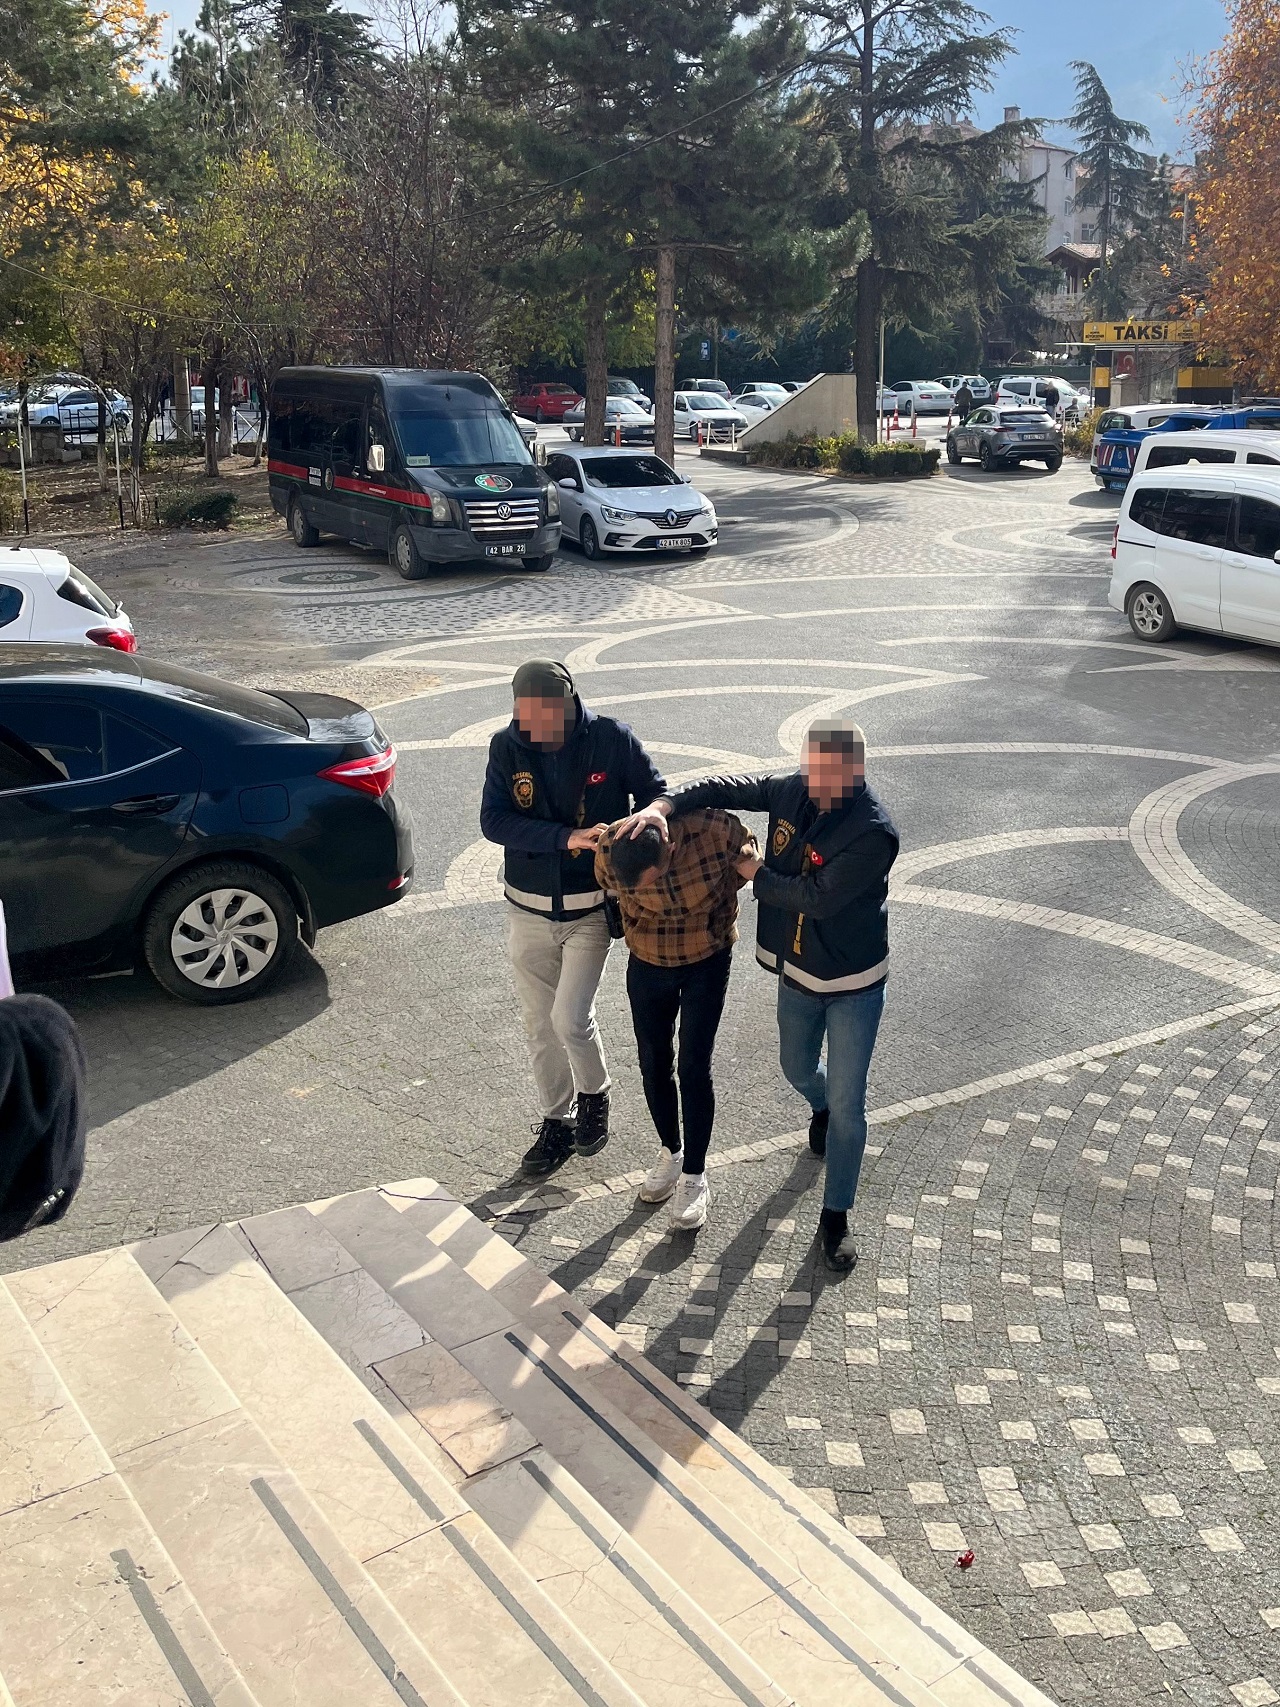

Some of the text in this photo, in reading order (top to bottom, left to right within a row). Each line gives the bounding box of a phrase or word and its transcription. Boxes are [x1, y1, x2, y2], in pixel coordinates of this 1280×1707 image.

[489, 544, 525, 555] 42 BAR 22
